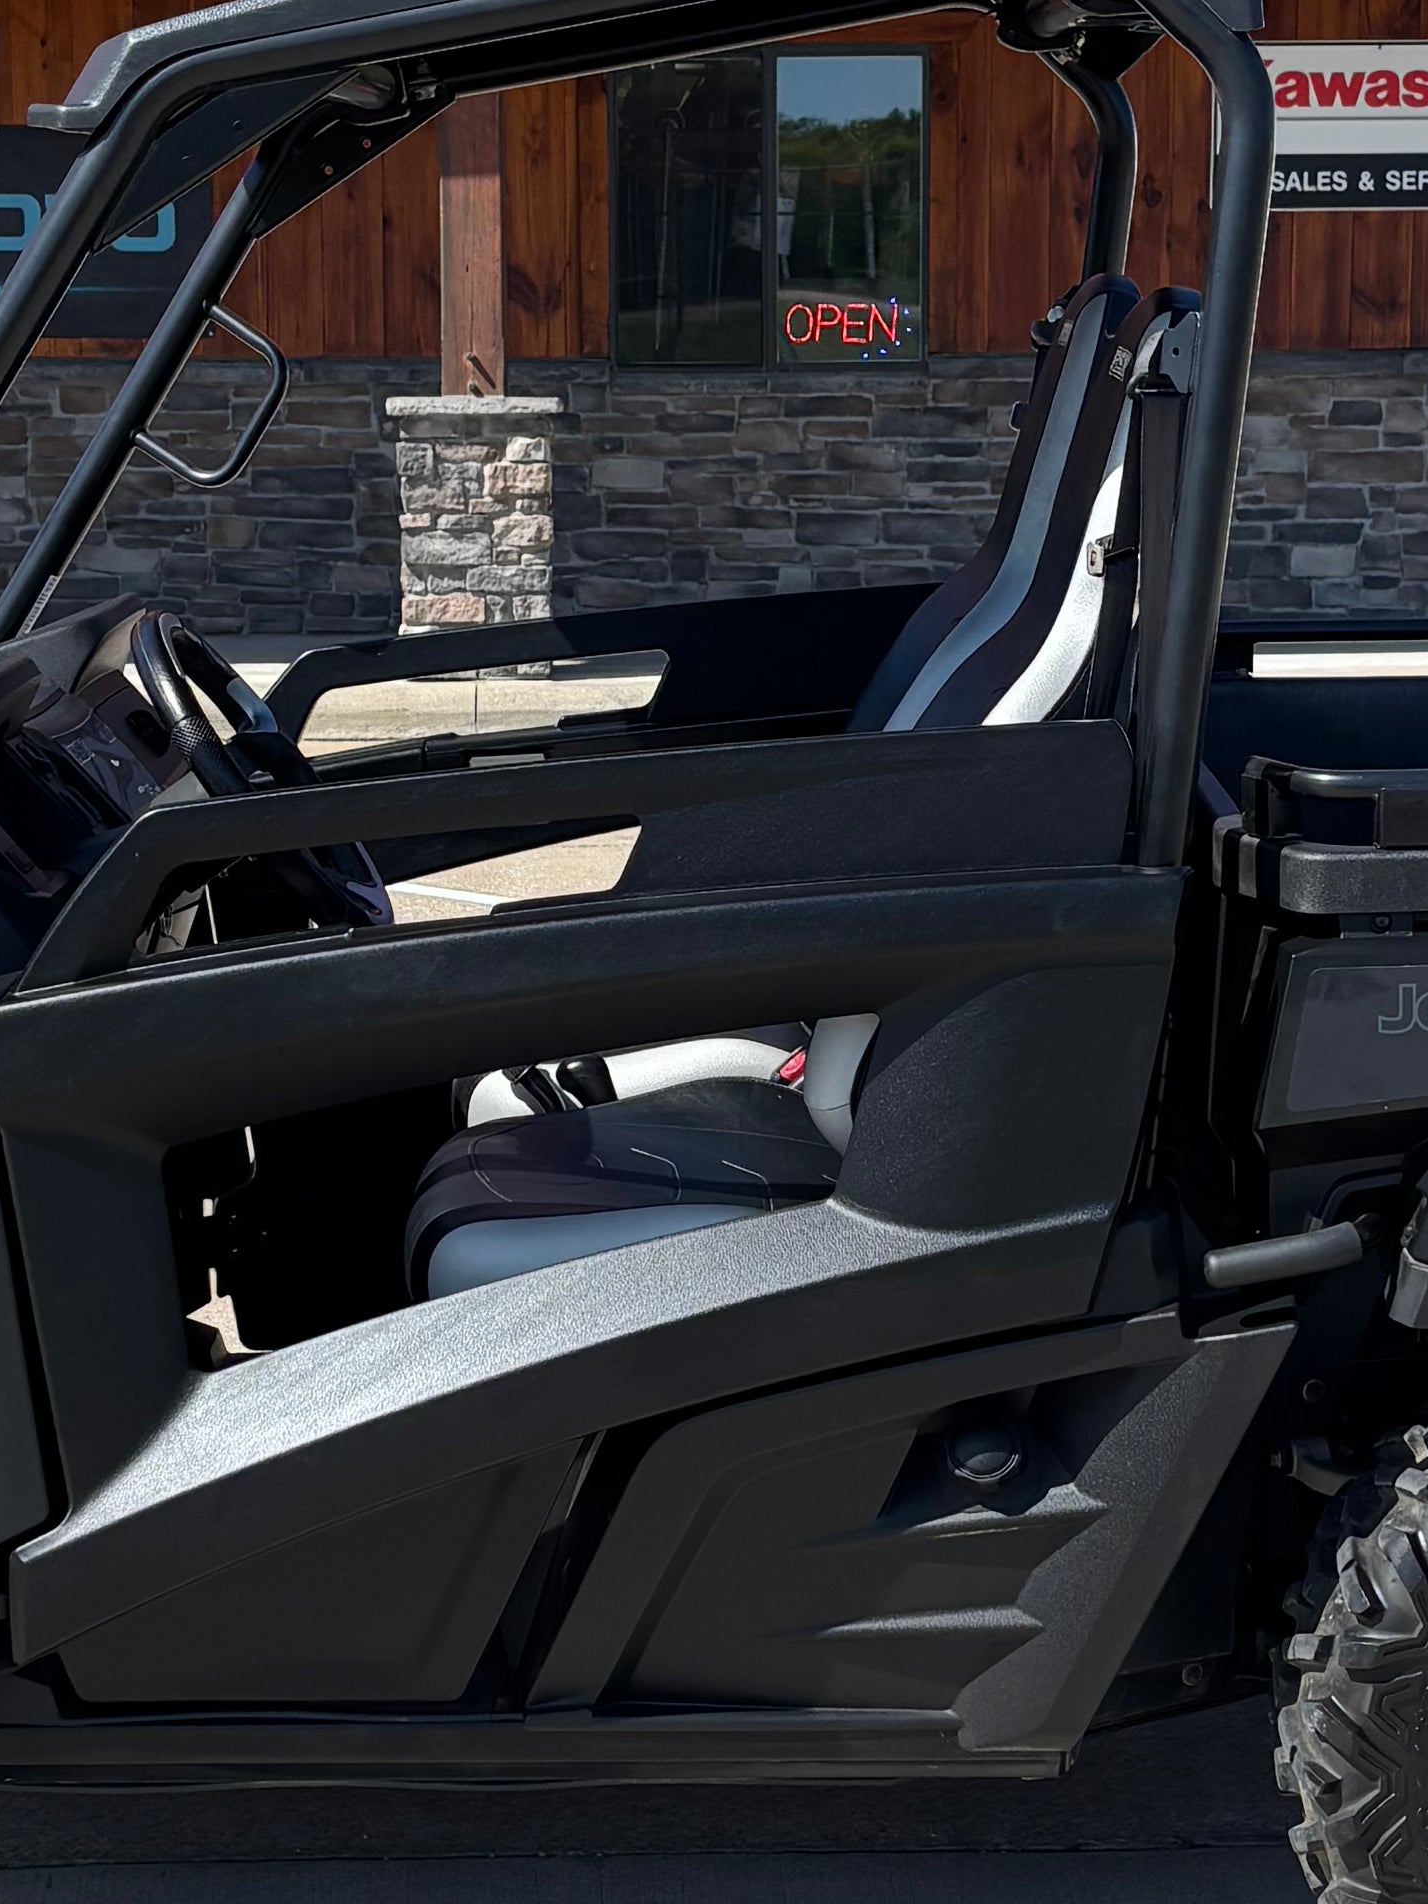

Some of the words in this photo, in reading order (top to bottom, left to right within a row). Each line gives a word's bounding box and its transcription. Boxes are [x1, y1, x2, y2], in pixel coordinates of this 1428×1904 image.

[1271, 170, 1348, 192] SALES
[1358, 171, 1375, 191] &
[786, 302, 899, 345] OPEN
